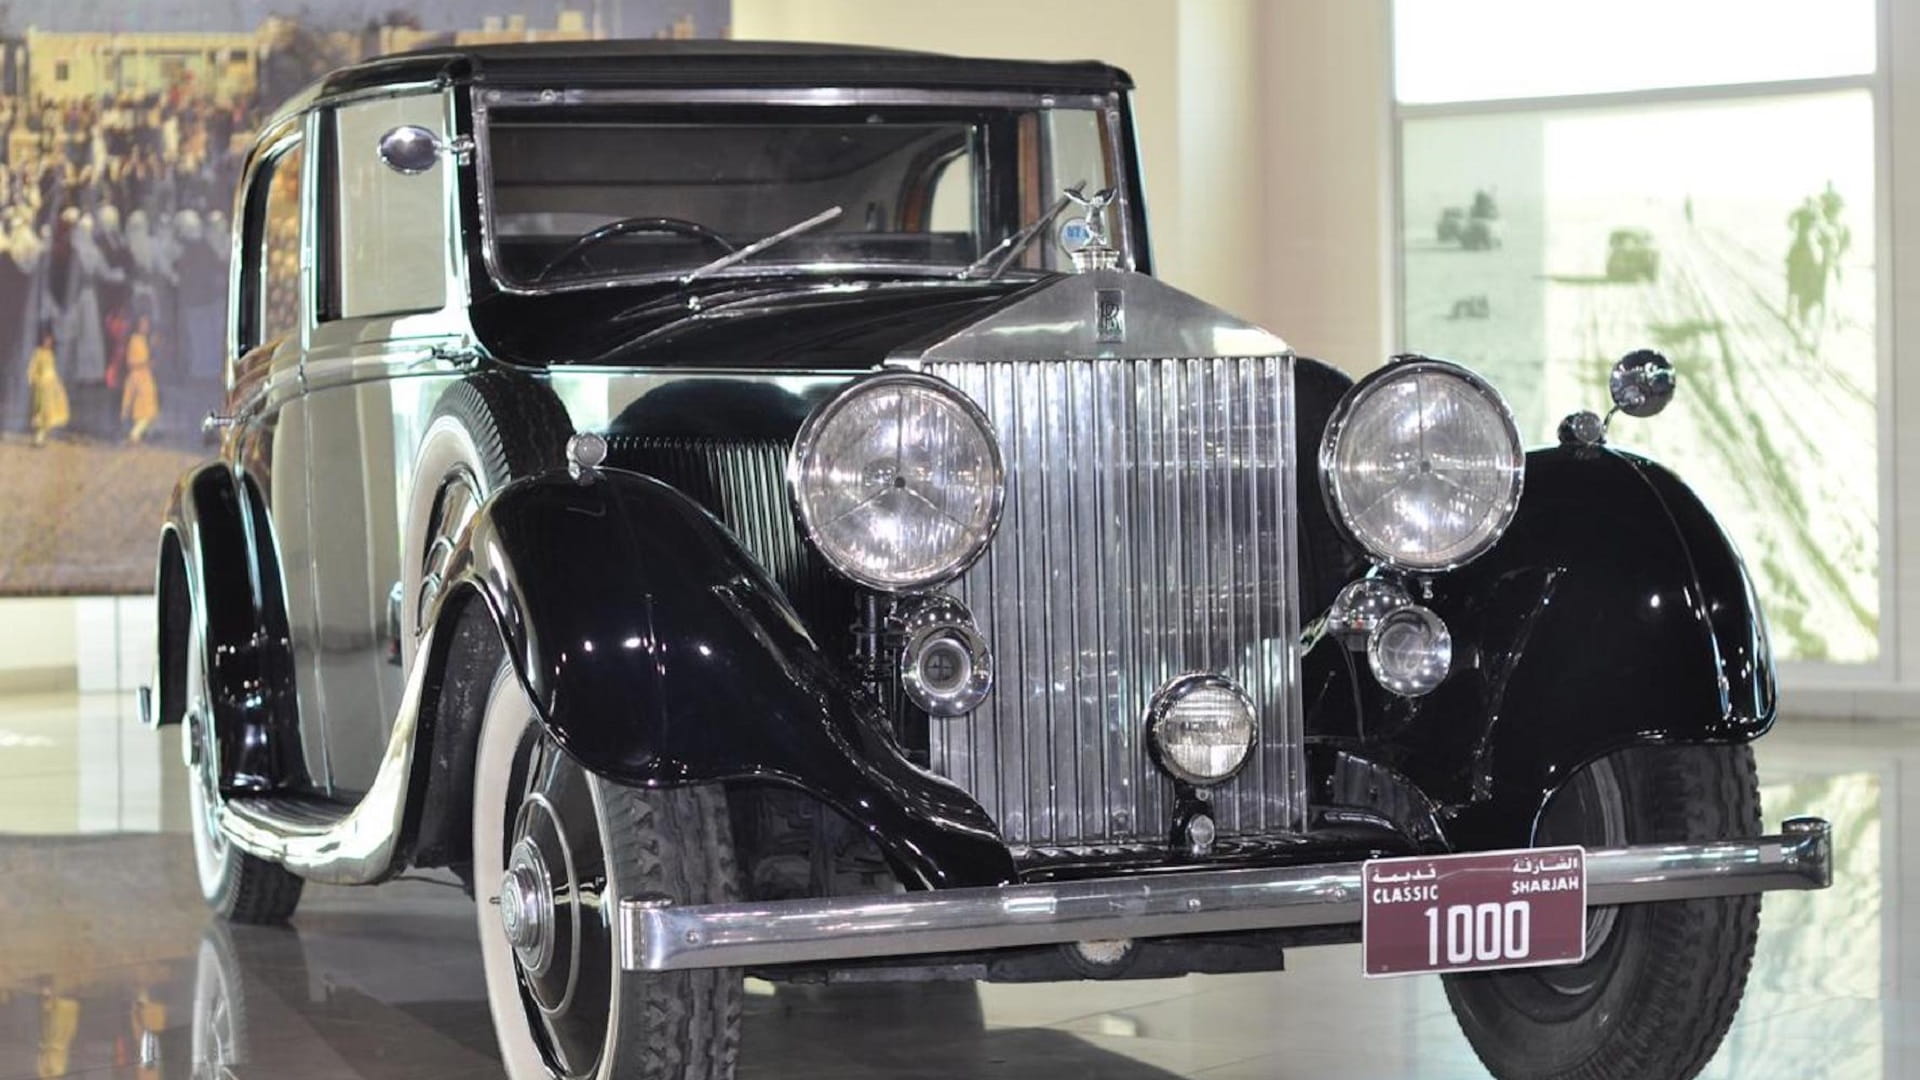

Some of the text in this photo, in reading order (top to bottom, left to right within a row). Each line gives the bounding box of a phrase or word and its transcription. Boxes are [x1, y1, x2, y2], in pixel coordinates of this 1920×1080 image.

[1372, 863, 1437, 884] قديمة
[1512, 856, 1578, 875] الشارقة
[1373, 885, 1439, 904] CLASSIC
[1512, 877, 1579, 895] SHARJAH
[1424, 901, 1531, 966] 1000
